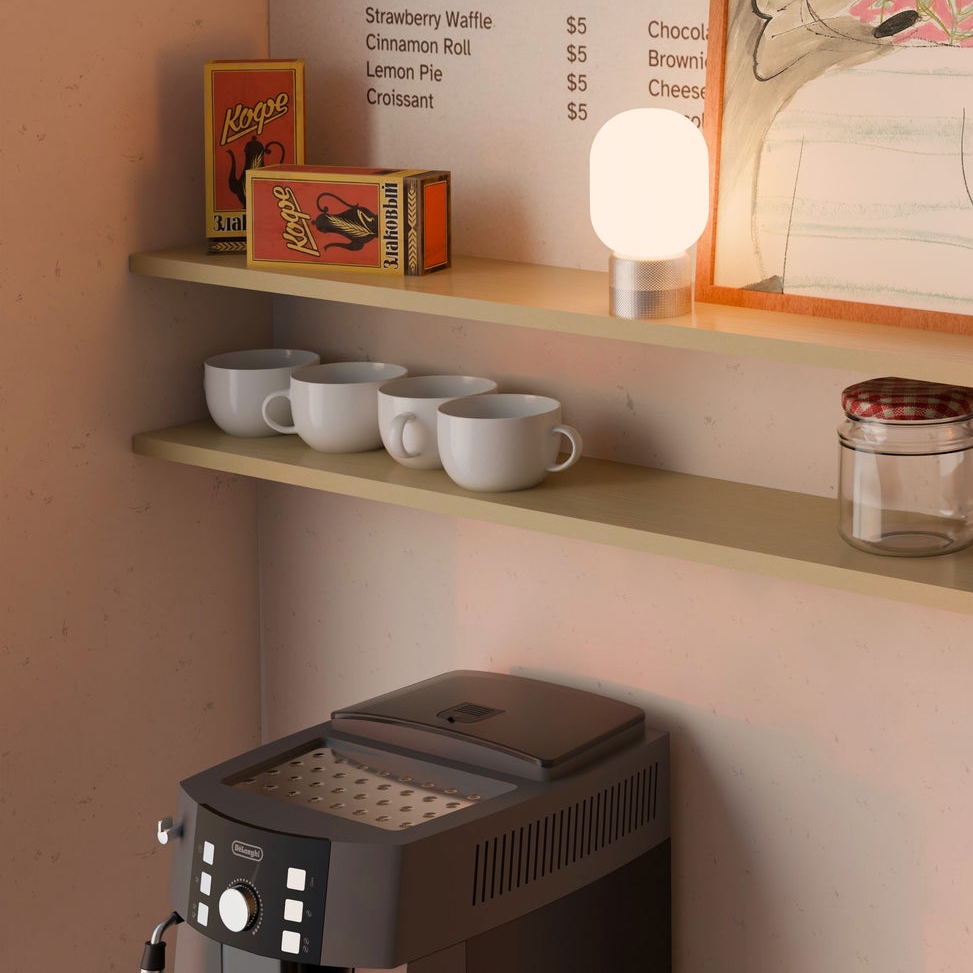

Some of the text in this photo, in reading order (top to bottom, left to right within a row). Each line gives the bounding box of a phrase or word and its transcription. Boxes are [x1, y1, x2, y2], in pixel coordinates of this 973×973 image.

[365, 7, 494, 30] Strawberry Waffle
[567, 15, 587, 35] $5
[366, 34, 471, 56] Cinnamon Roll
[567, 43, 587, 64] $5
[649, 49, 706, 69] Browni
[366, 60, 443, 82] Lemon Pie
[567, 72, 587, 92] $5
[367, 88, 434, 109] Croissant
[567, 101, 587, 121] $5
[382, 182, 399, 270] Злаковый
